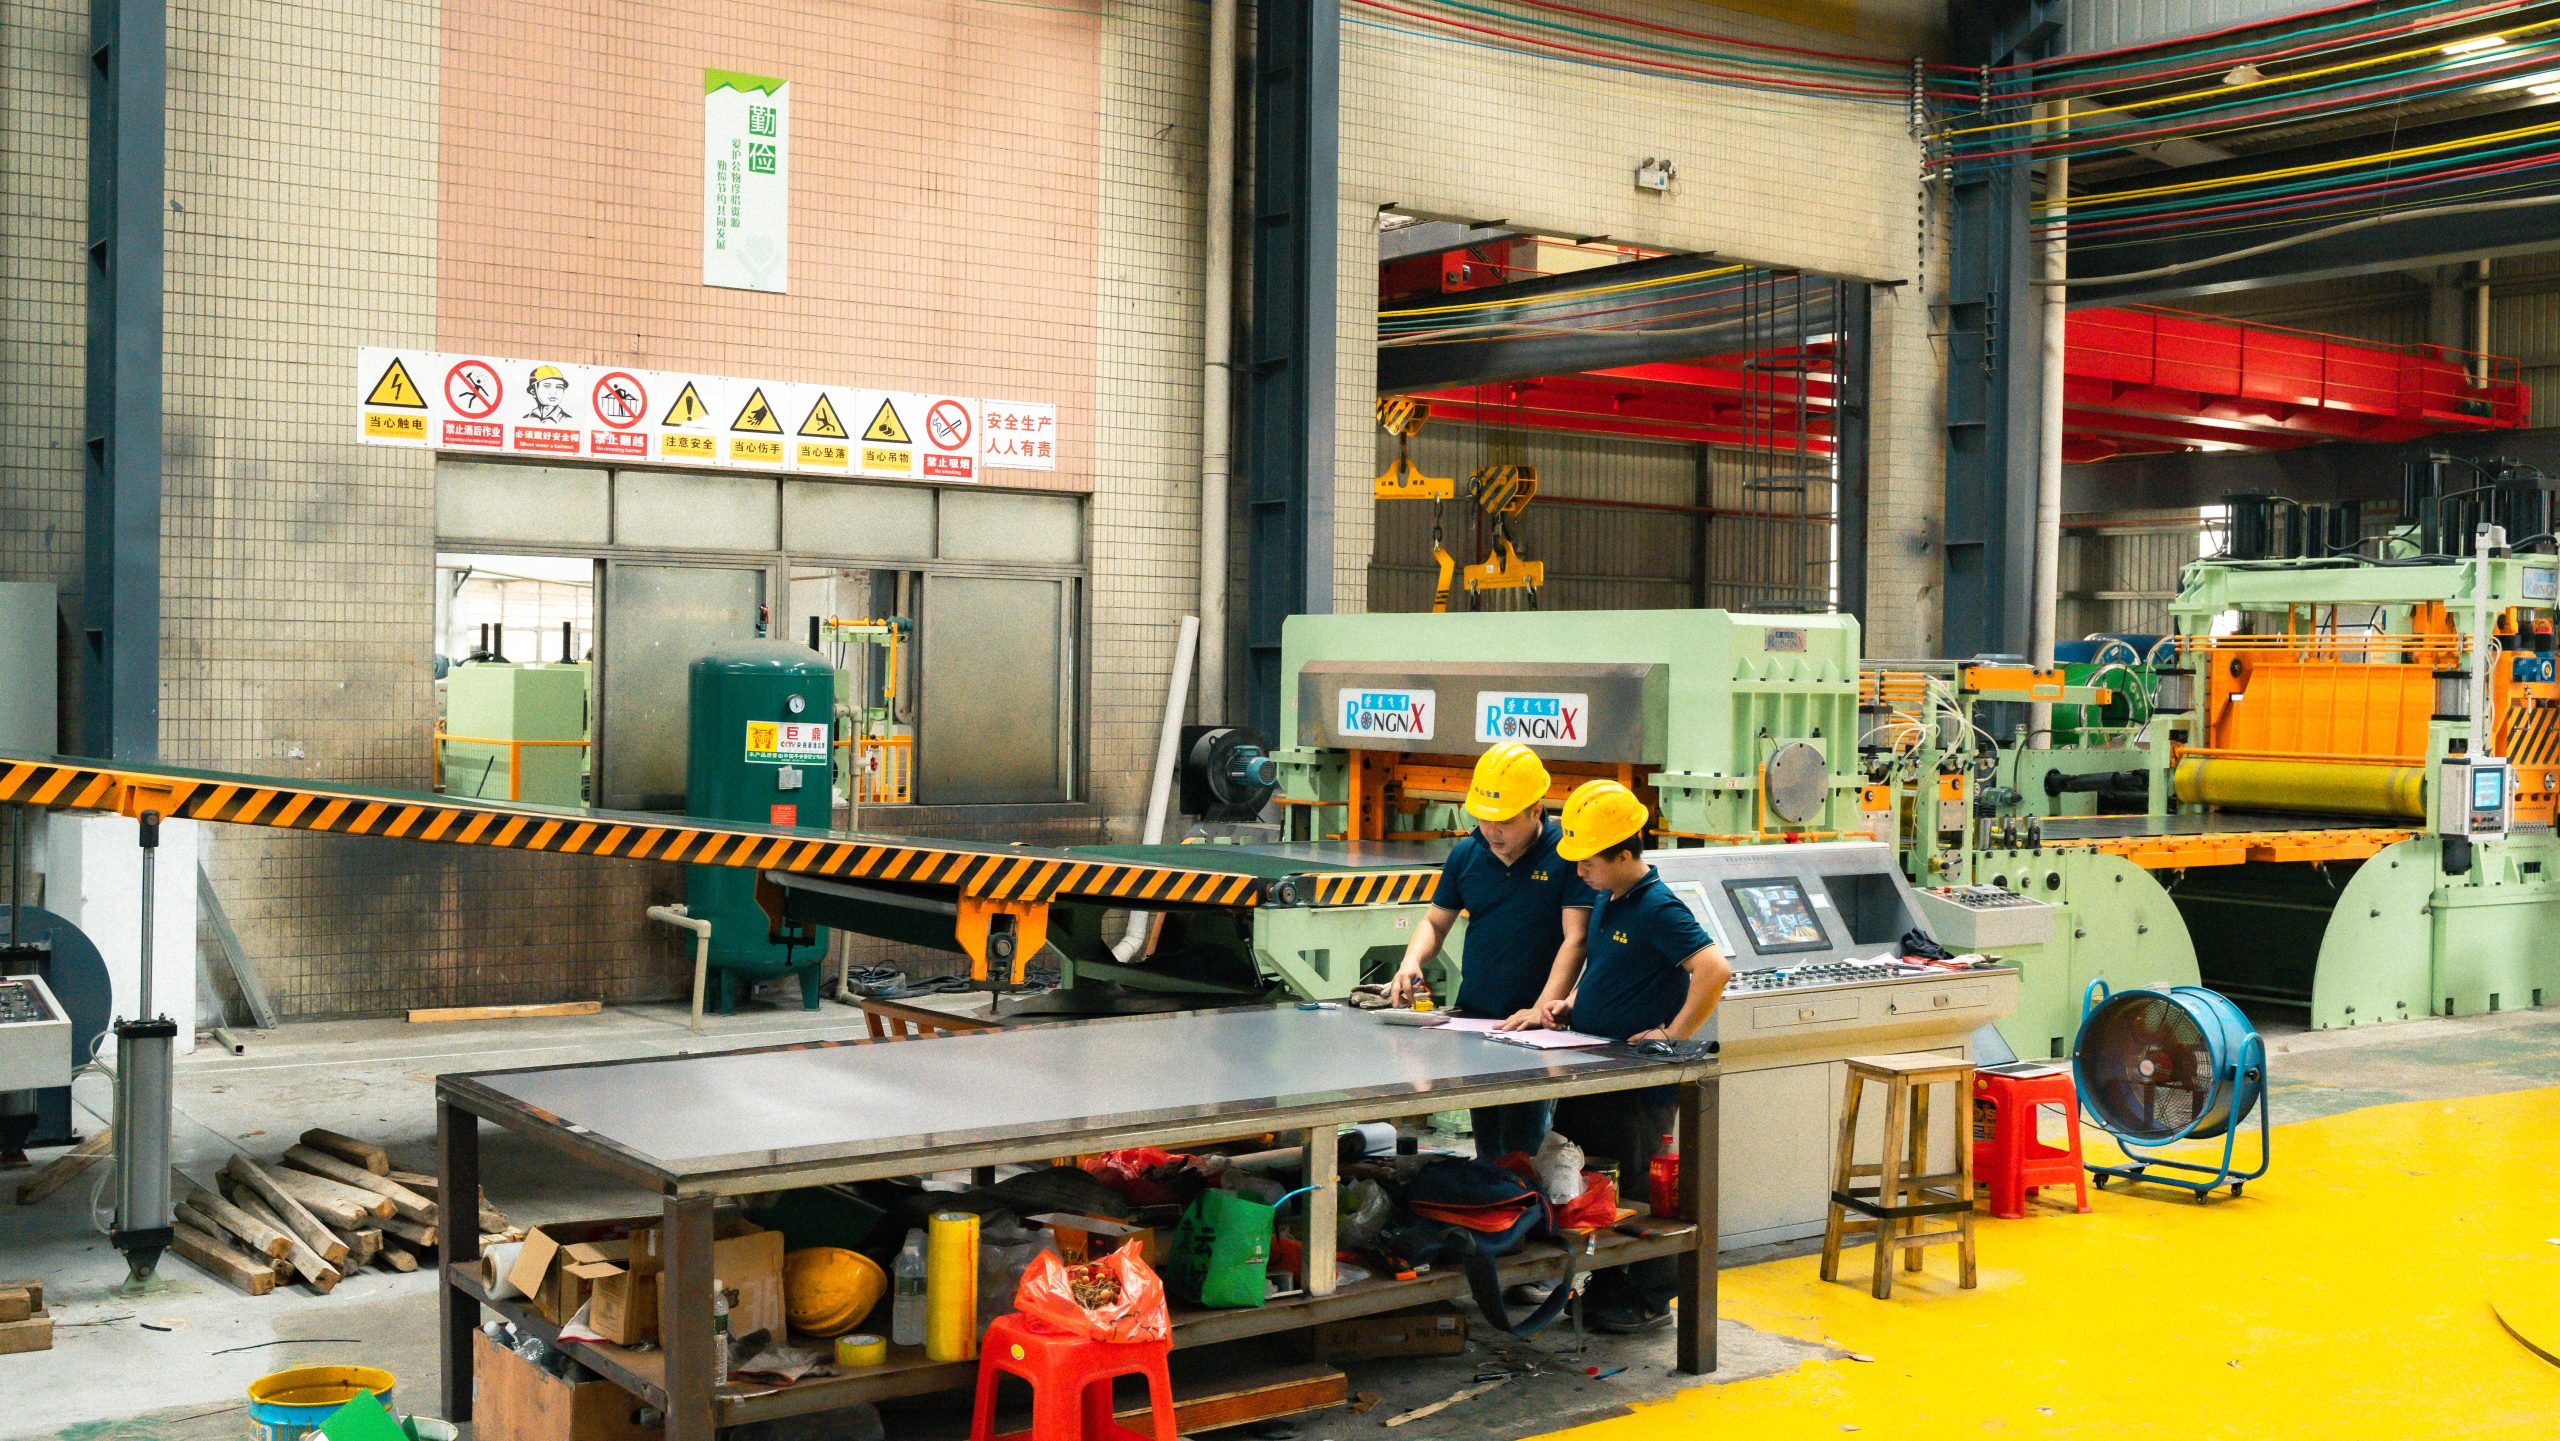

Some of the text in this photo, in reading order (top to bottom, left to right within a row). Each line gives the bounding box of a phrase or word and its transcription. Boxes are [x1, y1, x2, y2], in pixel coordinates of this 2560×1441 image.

[749, 105, 776, 173] 勤俭
[370, 416, 424, 430] 当心触电
[986, 411, 1052, 432] 安全生产
[445, 423, 501, 438] 禁止酒后作业
[594, 431, 645, 448] 禁止翻越
[665, 436, 713, 450] 注意安全
[734, 441, 780, 454] 当心伤手
[801, 445, 846, 459] 当心坠落
[986, 437, 1052, 458] 人人有责
[866, 450, 909, 463] 当心吊物
[927, 456, 970, 470] 禁止吸烟
